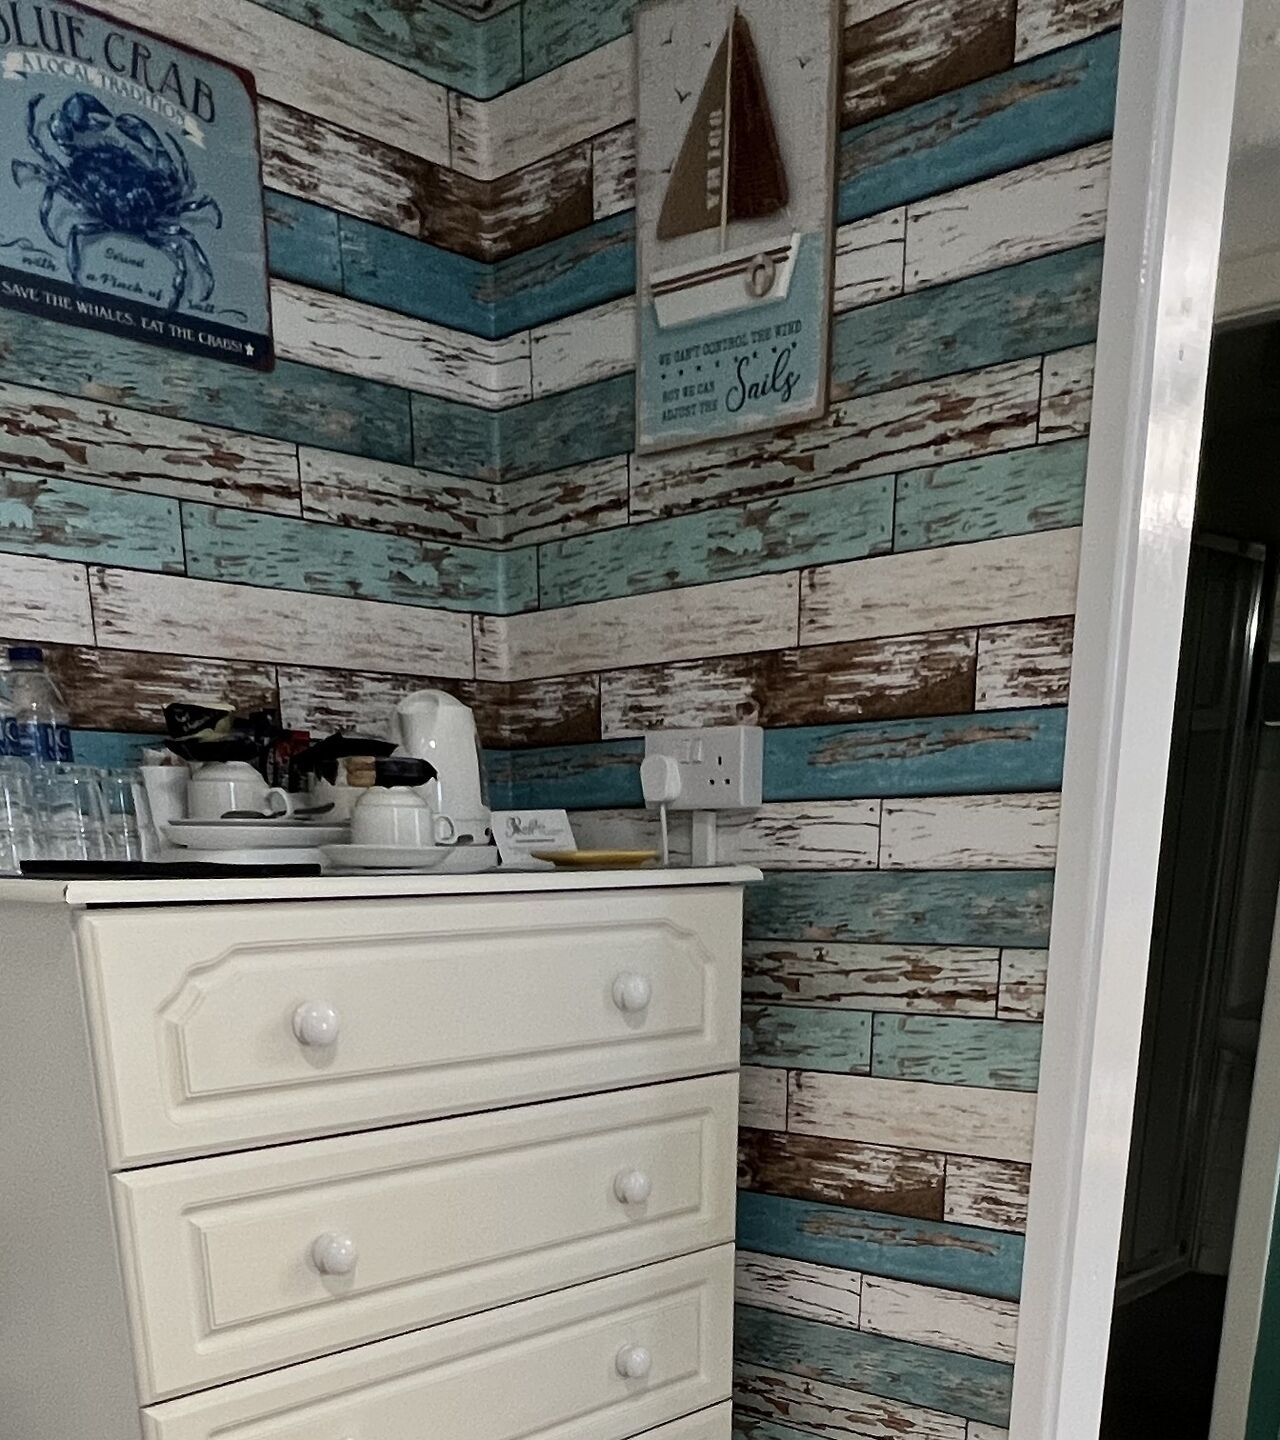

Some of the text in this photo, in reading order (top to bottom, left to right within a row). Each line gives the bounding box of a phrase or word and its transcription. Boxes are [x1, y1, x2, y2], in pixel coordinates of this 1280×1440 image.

[37, 55, 90, 84] LOCAL
[103, 31, 215, 124] CRAB
[100, 272, 144, 295] Pinch
[0, 280, 41, 303] SAVE
[43, 289, 73, 310] THE
[140, 316, 165, 333] EAT
[167, 321, 196, 340] THE
[702, 334, 749, 356] CONTROL
[750, 327, 772, 344] THE
[774, 319, 802, 338] WIND
[662, 380, 716, 403] BUT WE CAN
[725, 347, 801, 413] Sails
[662, 399, 719, 422] ADJUST THE
